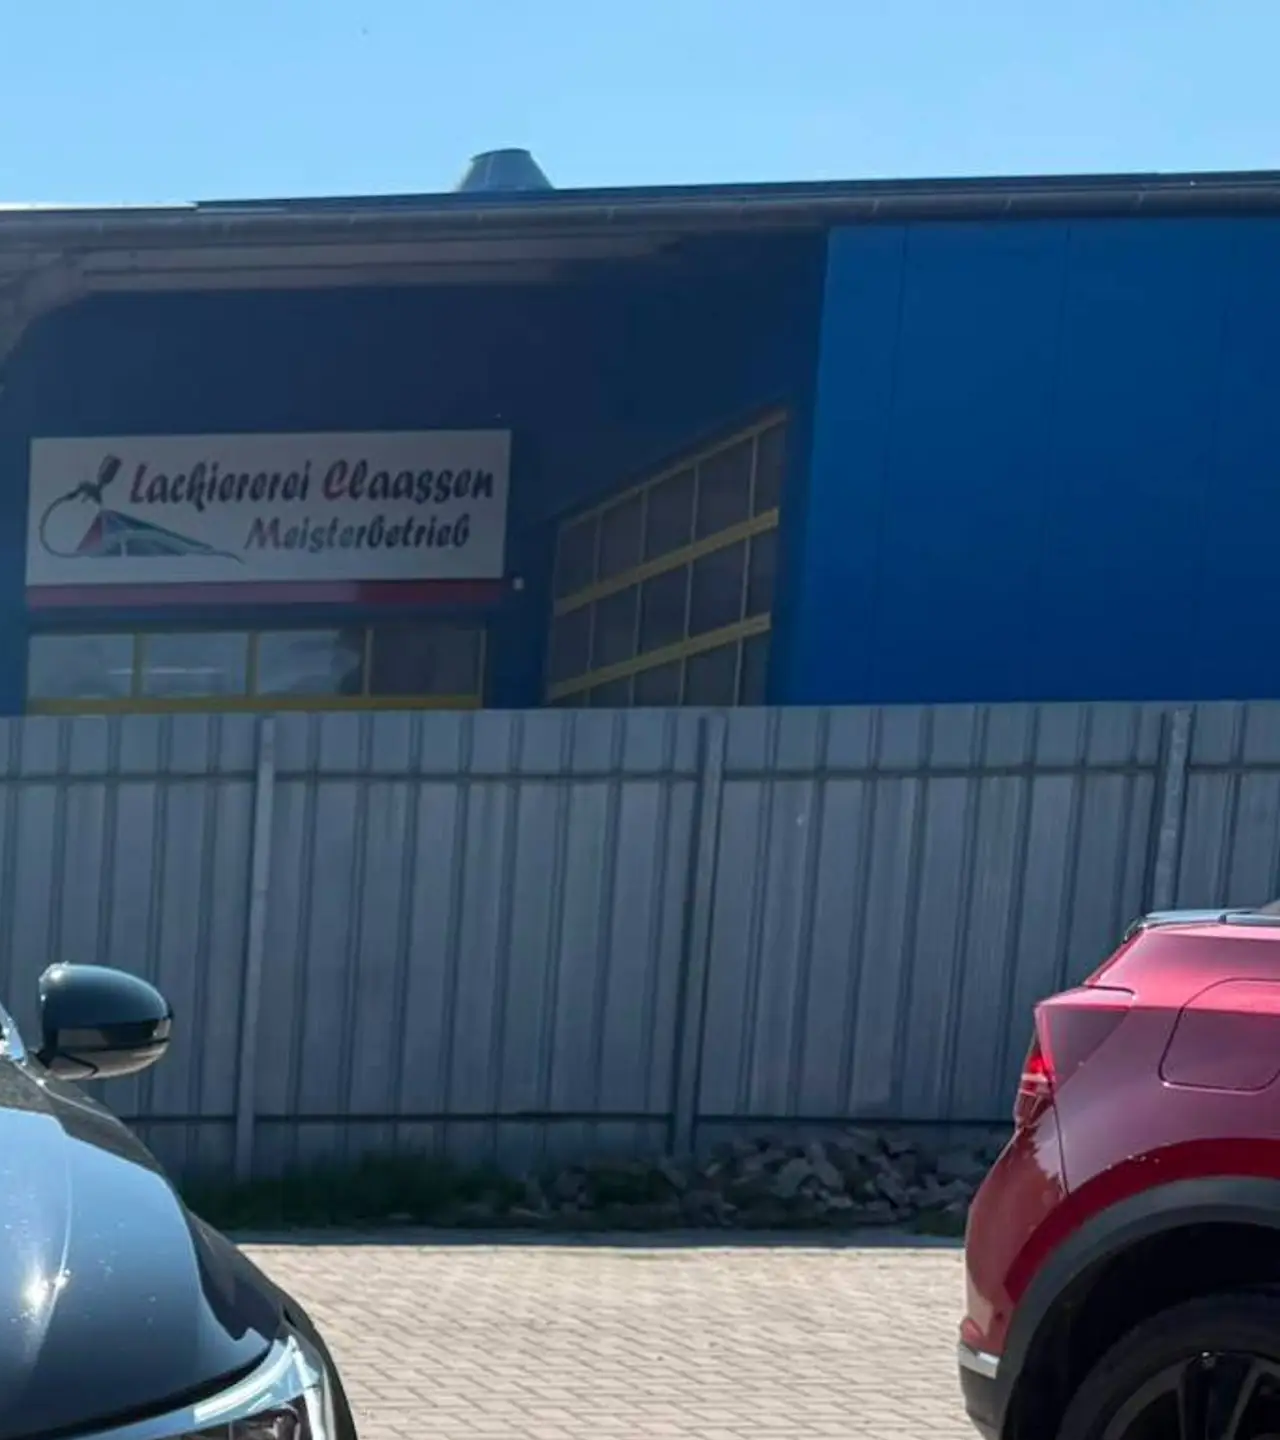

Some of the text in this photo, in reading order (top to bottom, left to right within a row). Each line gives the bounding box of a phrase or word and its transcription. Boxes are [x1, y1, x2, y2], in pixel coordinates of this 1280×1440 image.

[130, 459, 494, 512] Lackiererei Claassen
[243, 513, 470, 553] Meisterbetrieb
